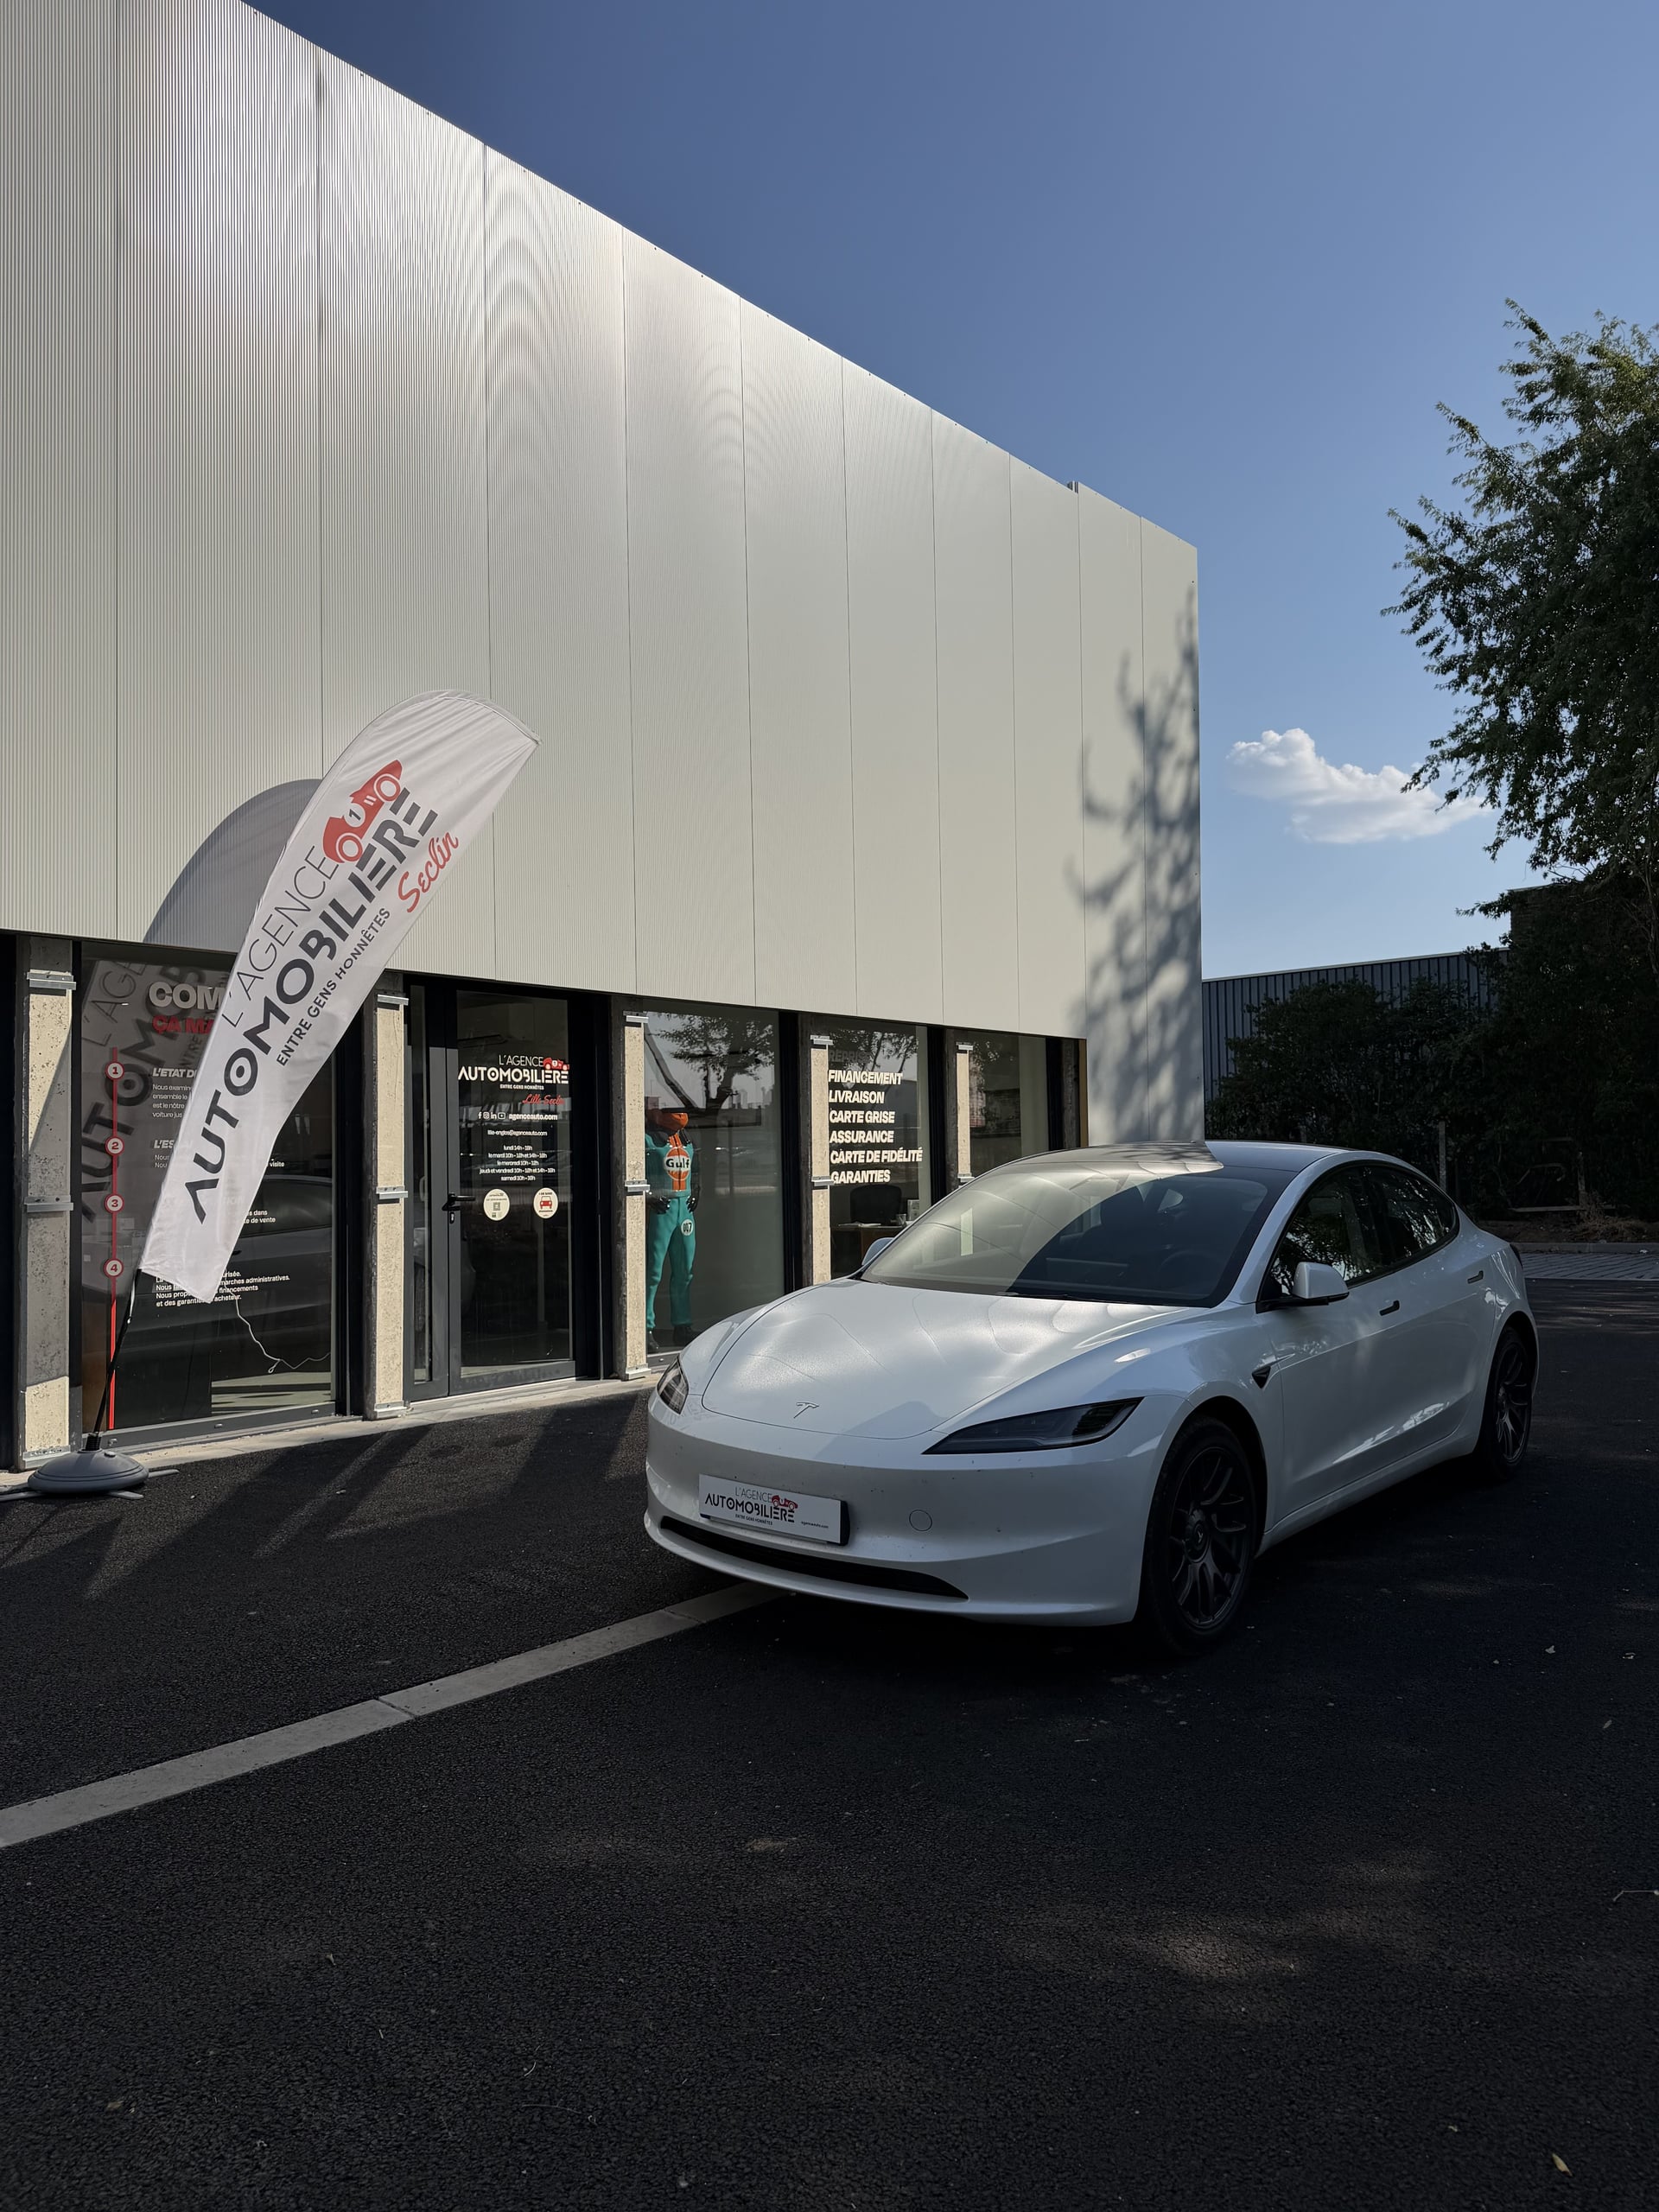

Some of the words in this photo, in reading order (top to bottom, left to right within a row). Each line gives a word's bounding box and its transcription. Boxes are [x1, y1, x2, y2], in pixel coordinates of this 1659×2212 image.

[348, 808, 361, 821] 1
[397, 831, 460, 913] Seclin
[221, 845, 340, 1028] L'AGENCE
[276, 1018, 313, 1066] ENTRE
[307, 979, 338, 1018] GENS
[334, 907, 391, 981] HONNÊTES
[149, 981, 226, 1011] COM
[152, 1014, 181, 1035] ÇA
[185, 1017, 214, 1035] MA
[499, 1054, 544, 1067] L'AGENCE
[112, 1066, 118, 1075] 1
[152, 1067, 186, 1078] L'ETAT
[828, 1069, 904, 1085] FINANCEMENT
[828, 1090, 885, 1104] LIVRAISON
[508, 1112, 558, 1121] agenceauto.com
[829, 1110, 864, 1123] CARTE
[865, 1110, 896, 1124] GRISE
[829, 1130, 894, 1144] ASSURANCE
[111, 1141, 119, 1150] 2
[154, 1140, 175, 1149] L'ES
[830, 1150, 865, 1164] CARTE
[866, 1150, 881, 1163] DE
[881, 1147, 924, 1163] FIDÉLITÉ
[665, 1158, 690, 1169] Gulf
[830, 1169, 891, 1185] GARANTIES
[111, 1199, 119, 1208] 3
[110, 1264, 118, 1273] 4
[734, 1486, 772, 1503] L'AGENCE
